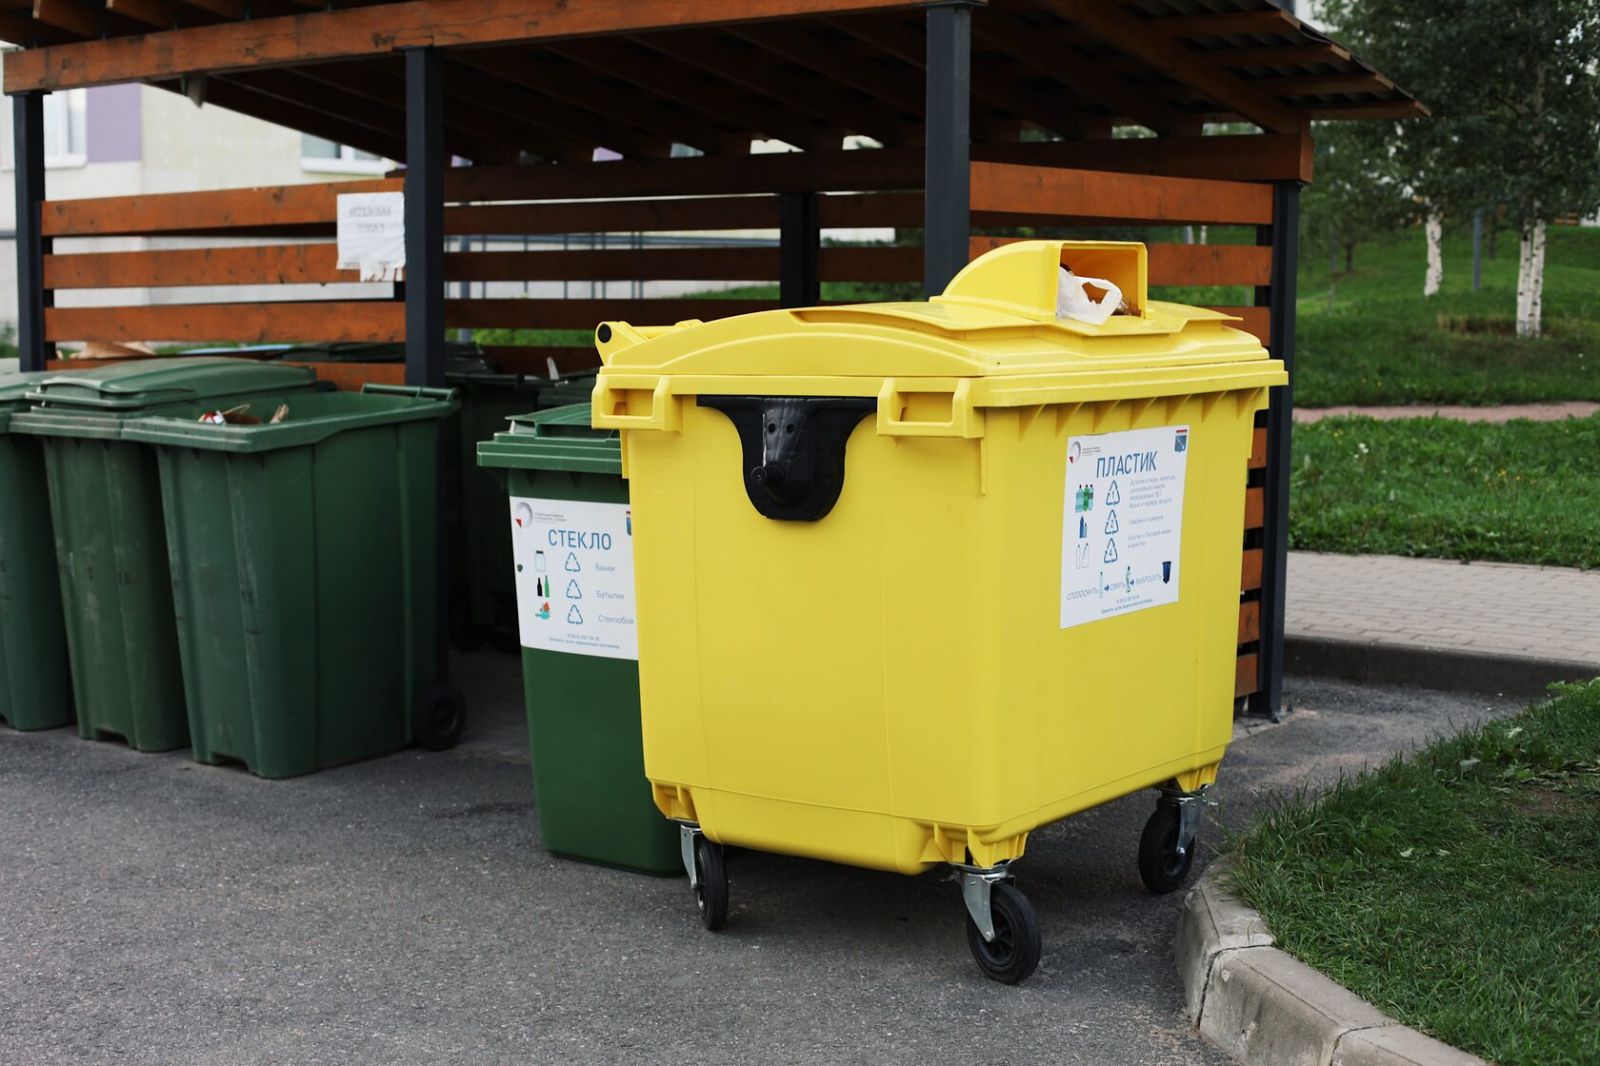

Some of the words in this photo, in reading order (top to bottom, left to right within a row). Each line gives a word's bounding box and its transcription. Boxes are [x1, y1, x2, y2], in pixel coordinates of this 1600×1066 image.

[1096, 450, 1157, 478] ПЛАСТИК
[548, 529, 612, 550] СТЕКЛО
[595, 562, 615, 572] Банки
[596, 590, 625, 600] Бутылки
[598, 614, 634, 625] Стеклобой
